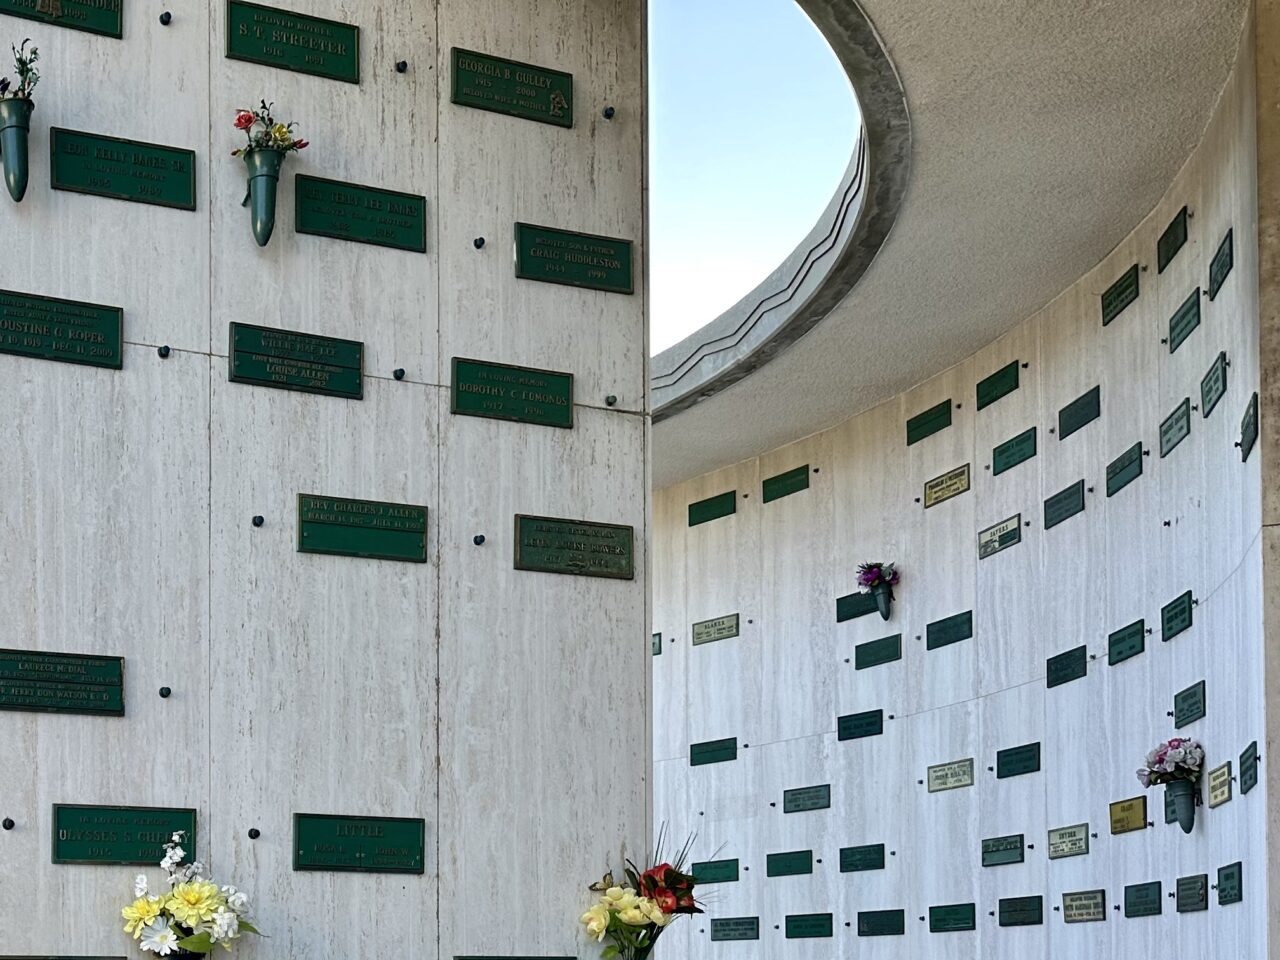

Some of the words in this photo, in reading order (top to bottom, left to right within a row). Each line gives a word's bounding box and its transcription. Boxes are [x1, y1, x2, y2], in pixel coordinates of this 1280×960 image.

[273, 29, 346, 56] STREETER
[459, 57, 501, 78] GEORGIA
[516, 69, 552, 89] GULLEY
[475, 76, 493, 88] 1915
[515, 85, 536, 97] 2000
[94, 146, 127, 163] KELLY
[131, 152, 167, 169] BANKS
[330, 190, 359, 206] TERRY
[364, 196, 383, 211] LEE
[387, 201, 417, 217] BANKS
[530, 246, 561, 260] CRAIG
[564, 252, 621, 270] HUDDLESTON
[69, 328, 105, 344] ROPER
[24, 337, 42, 349] 1919
[91, 346, 113, 359] 2009
[266, 363, 298, 376] LOUISE
[300, 368, 329, 381] ALLEN
[489, 373, 517, 383] LOVING
[519, 377, 548, 388] MEMORY
[460, 382, 506, 397] DOROTHY
[522, 391, 567, 406] EDMONDS
[334, 502, 376, 515] CHARLES
[388, 507, 418, 519] ALLEN
[10, 687, 34, 696] JERRY
[37, 688, 54, 697] DON
[57, 689, 88, 699] WATSON
[59, 828, 118, 841] ULYSSES
[336, 823, 383, 837] LITTLE
